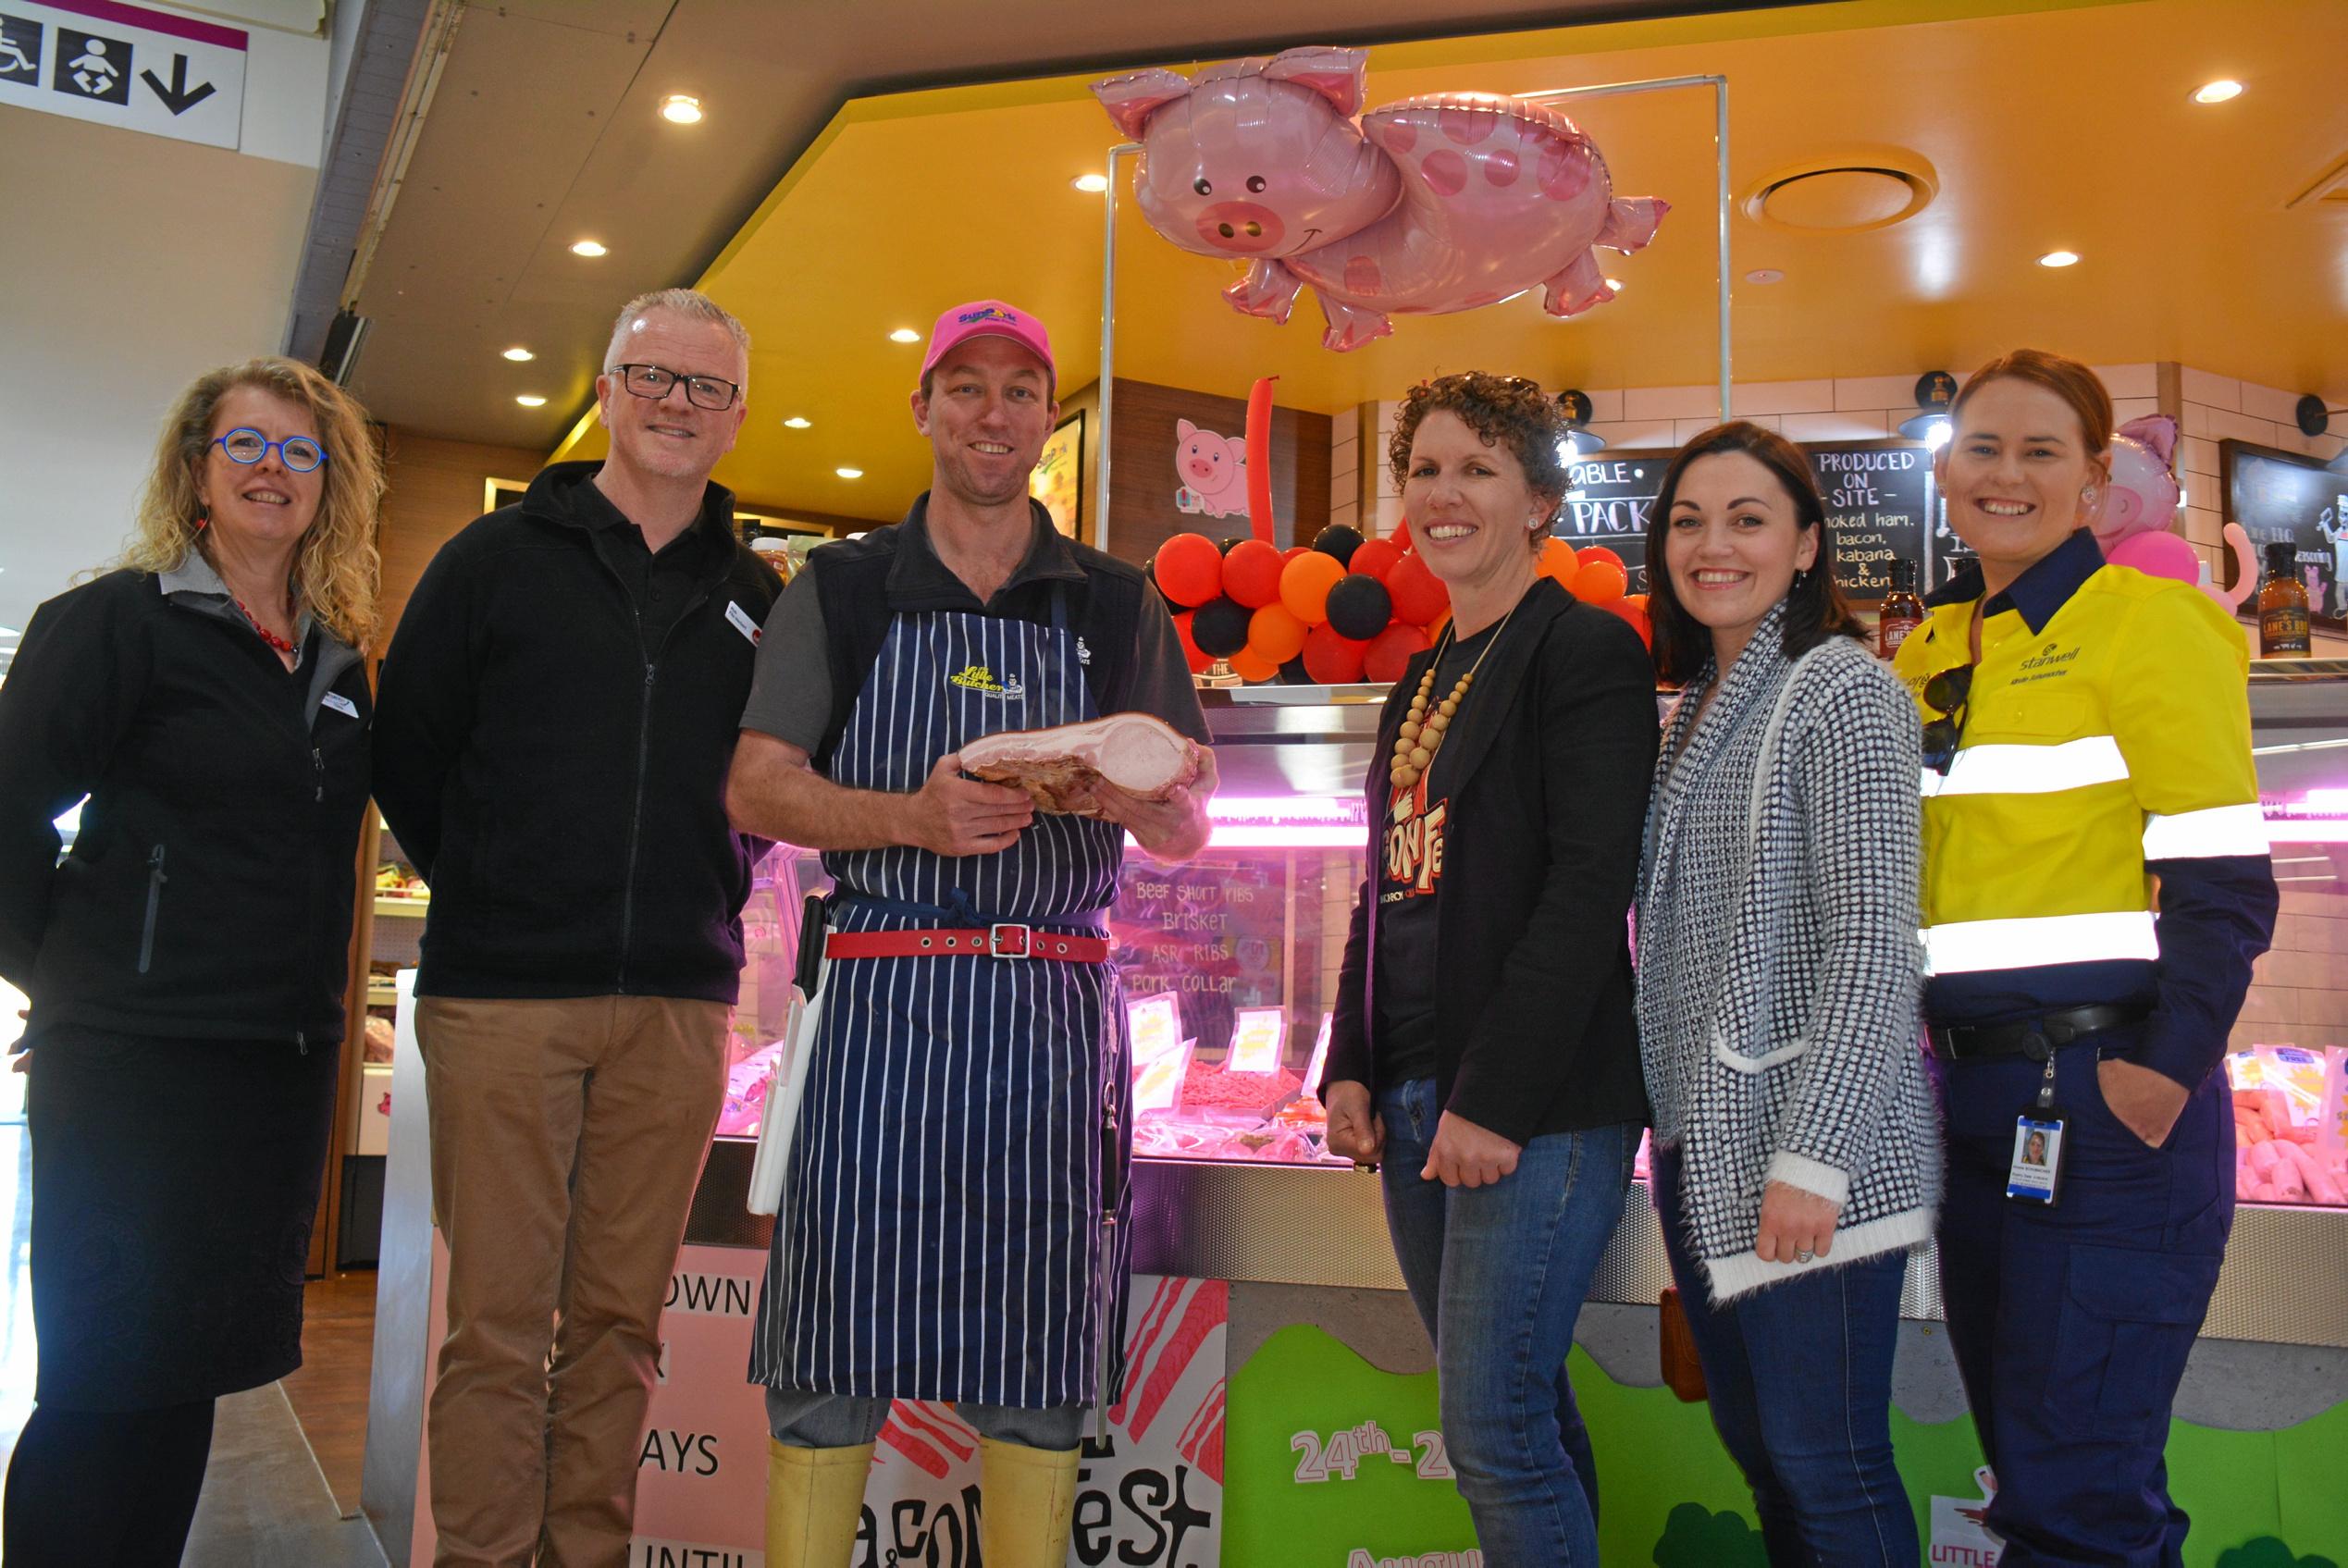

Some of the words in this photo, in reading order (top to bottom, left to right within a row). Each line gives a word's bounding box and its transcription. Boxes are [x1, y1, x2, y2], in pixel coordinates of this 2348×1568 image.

[1816, 452, 1914, 472] PRODUCED
[1844, 472, 1868, 488] ON
[1832, 488, 1879, 507] SITE
[1836, 549, 1896, 562] kabana
[2020, 647, 2081, 671] stanwell
[1213, 664, 1230, 675] THE
[1932, 1545, 1996, 1568] LITTLE
